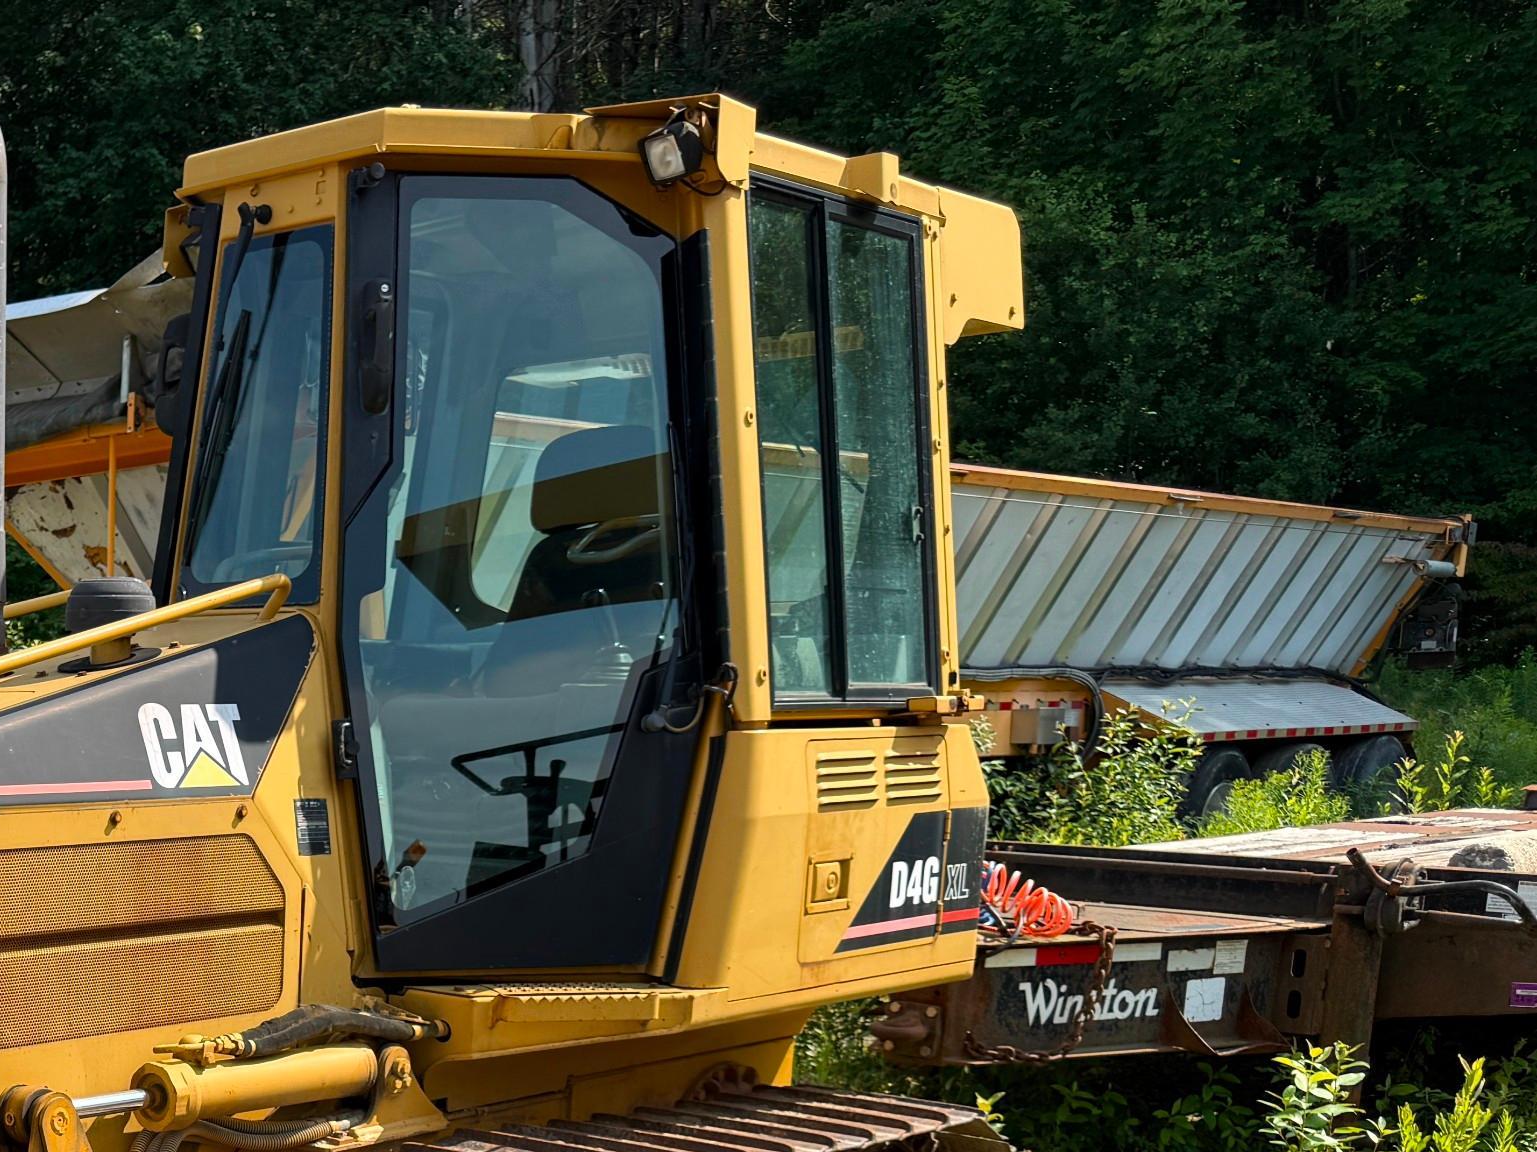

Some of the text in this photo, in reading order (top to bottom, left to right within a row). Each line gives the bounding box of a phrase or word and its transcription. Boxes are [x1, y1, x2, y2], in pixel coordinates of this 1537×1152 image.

[138, 702, 249, 789] CAT
[889, 856, 970, 908] D4G XL
